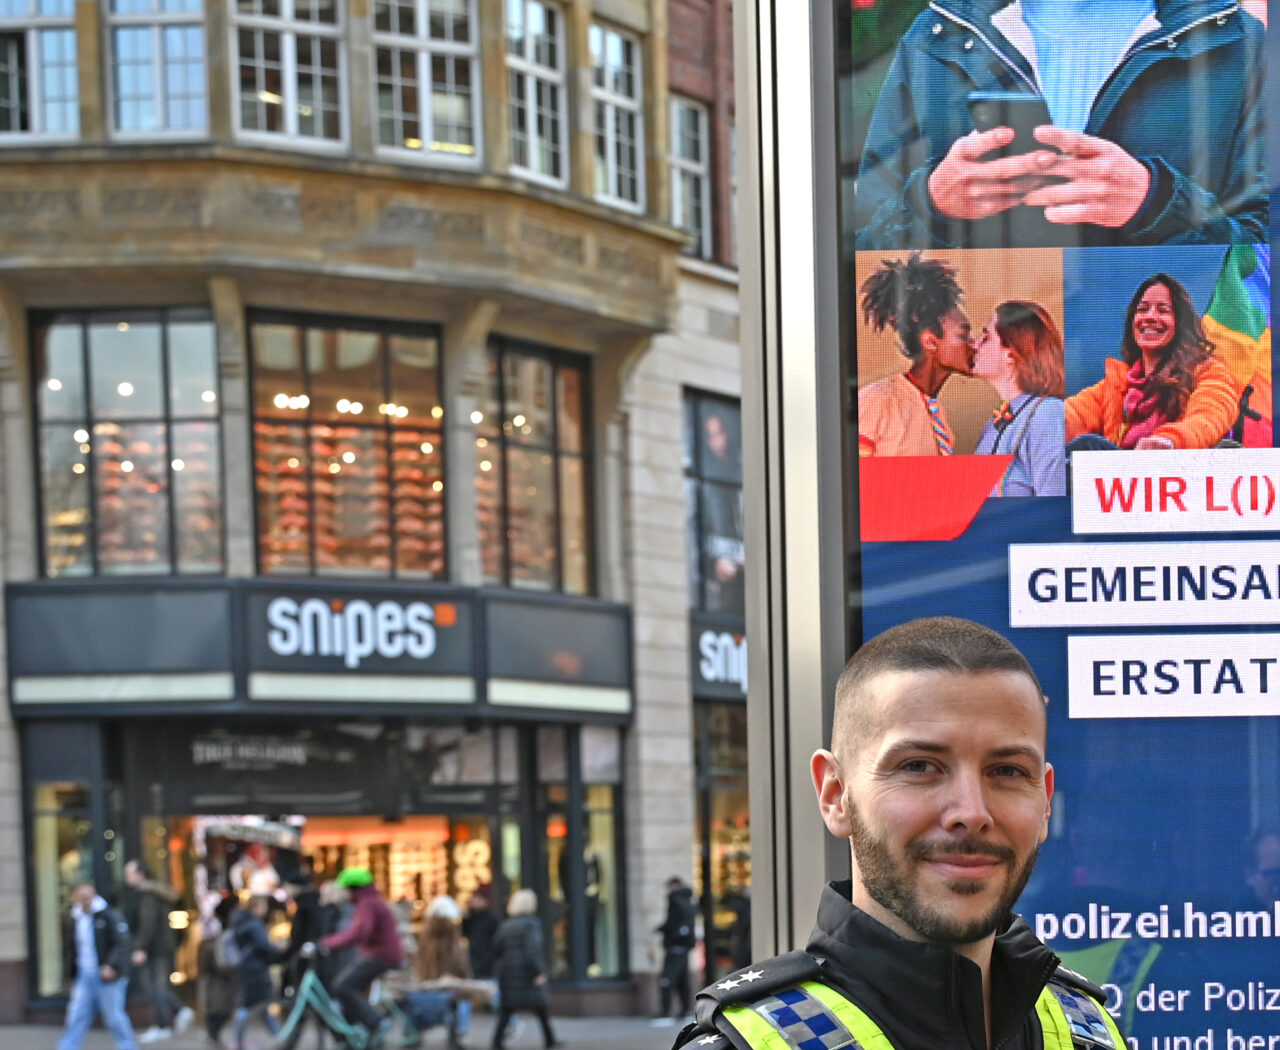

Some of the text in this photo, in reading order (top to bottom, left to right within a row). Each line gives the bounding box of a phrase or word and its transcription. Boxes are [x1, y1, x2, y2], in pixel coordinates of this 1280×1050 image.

[1094, 476, 1187, 513] WIR
[266, 597, 437, 668] snipes
[1136, 982, 1191, 1012] der
